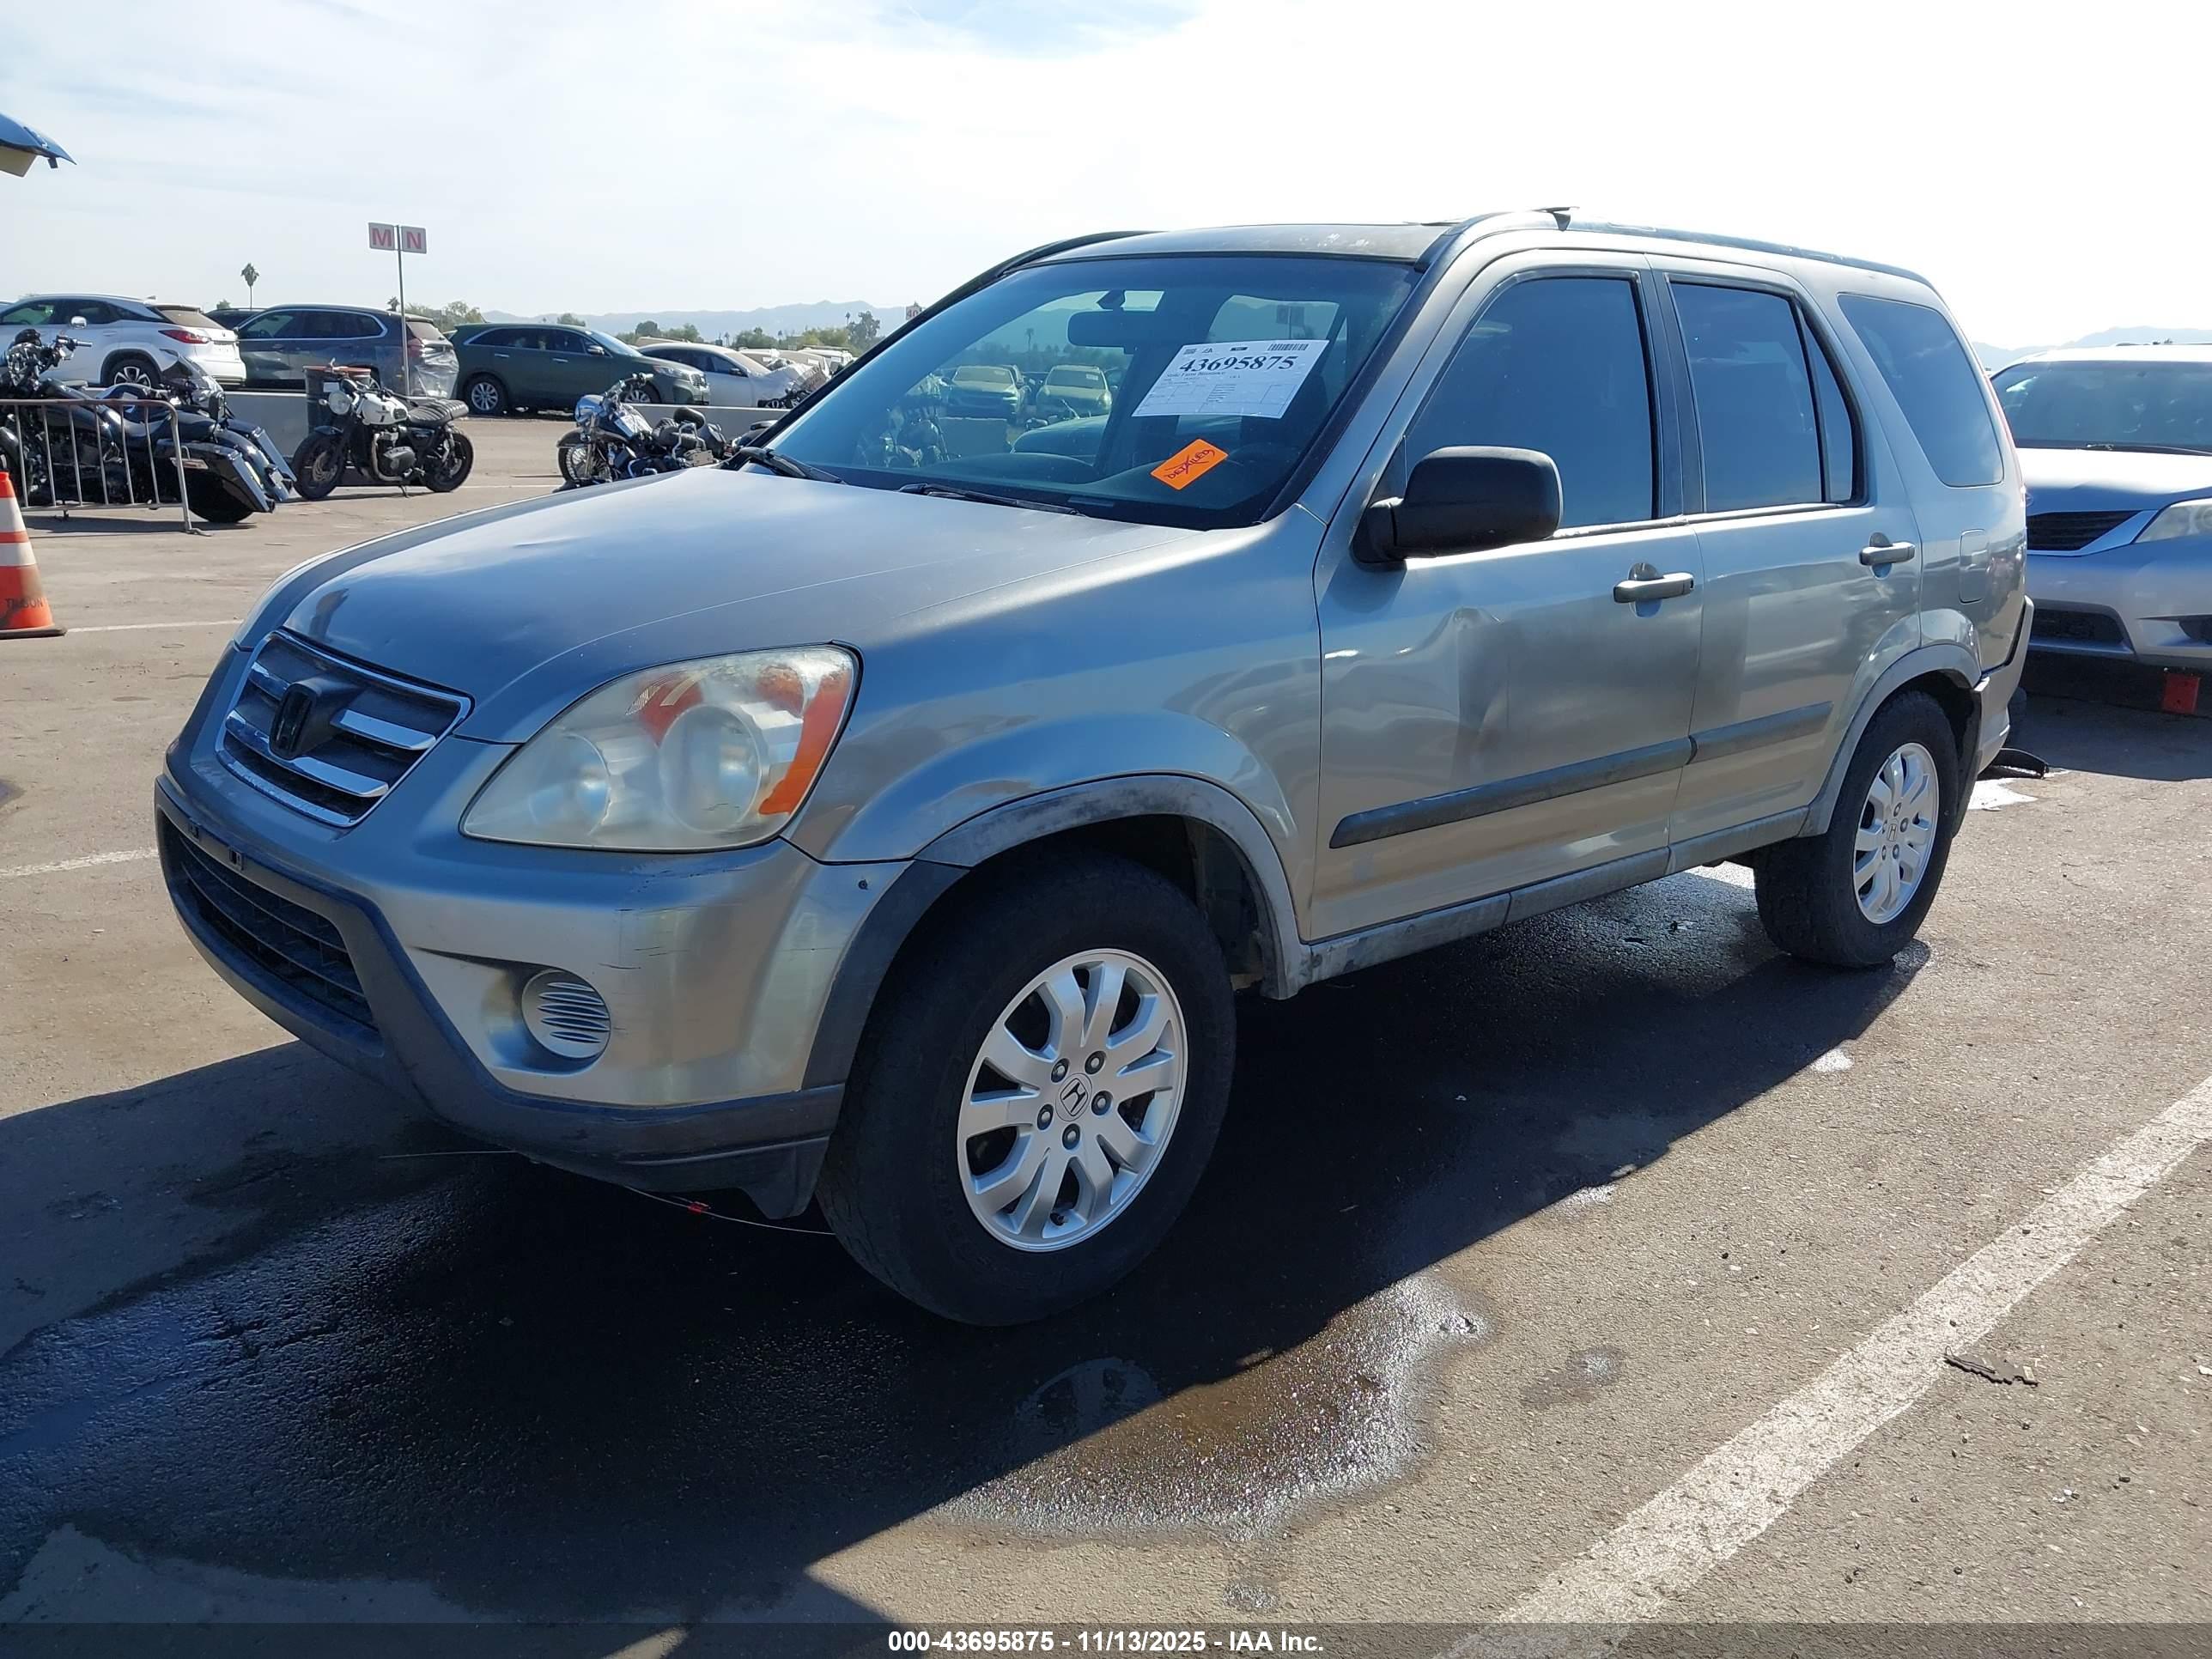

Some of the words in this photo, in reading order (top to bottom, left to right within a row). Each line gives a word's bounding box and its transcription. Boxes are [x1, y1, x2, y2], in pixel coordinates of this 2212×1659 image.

[372, 228, 392, 247] M
[405, 230, 422, 249] N
[1179, 356, 1298, 372] 43695875
